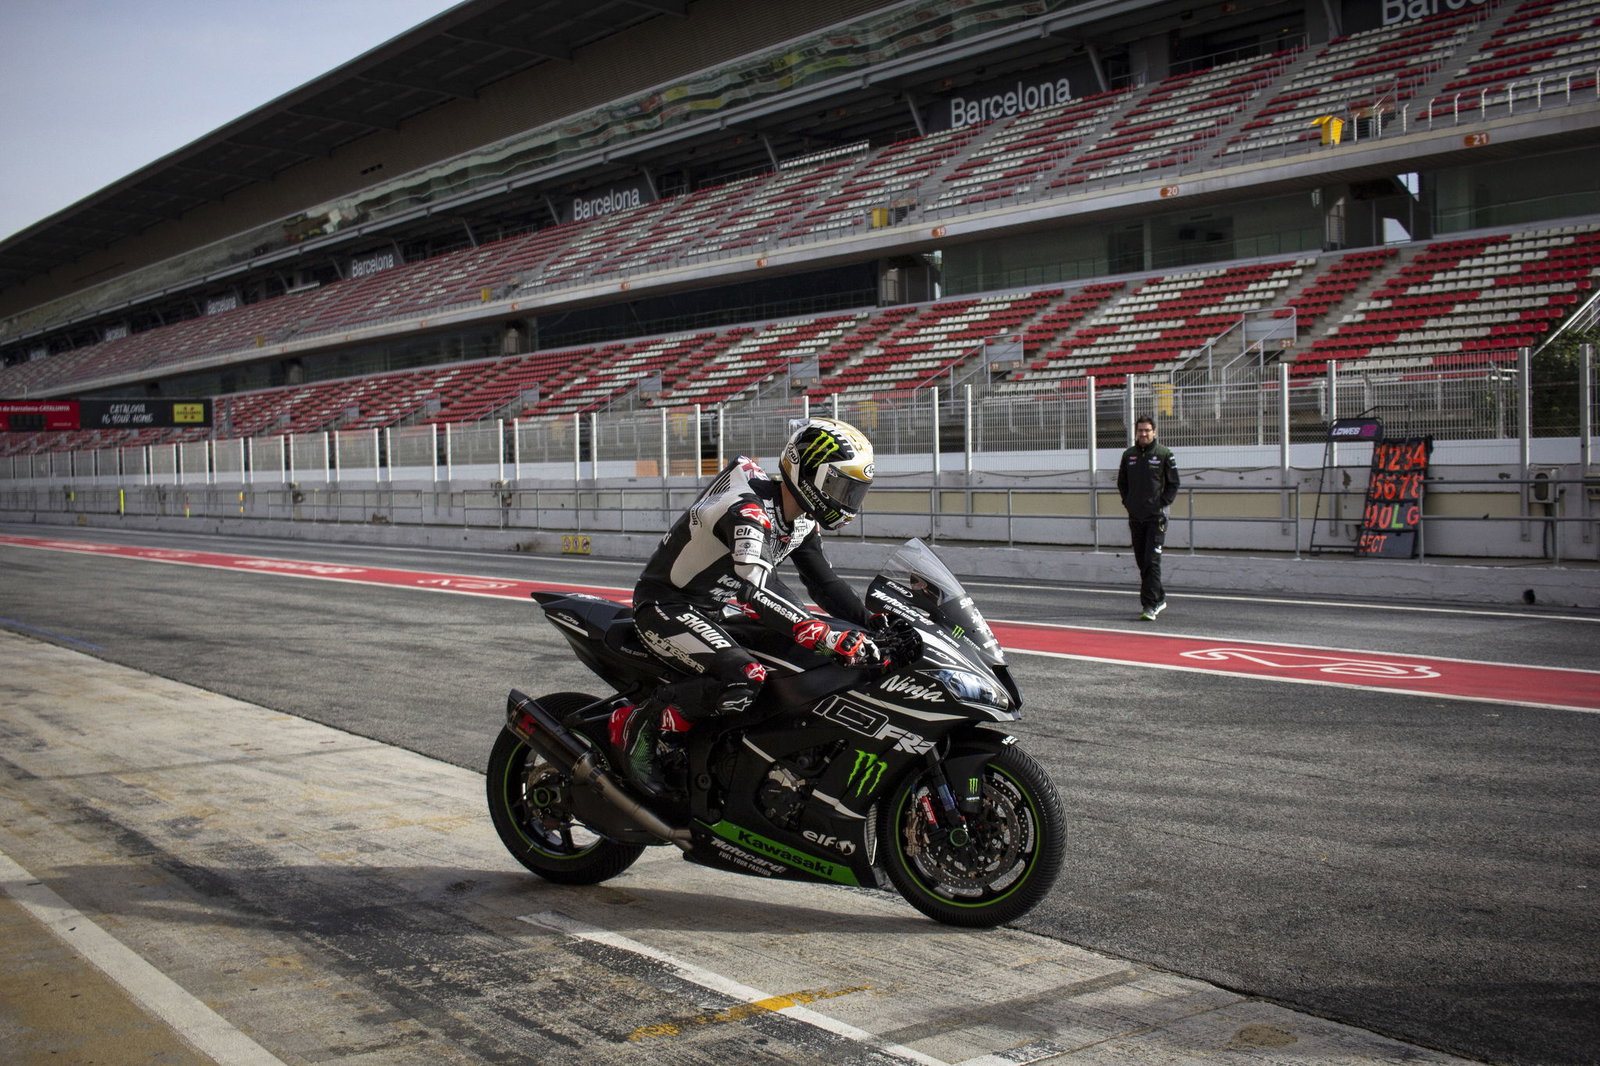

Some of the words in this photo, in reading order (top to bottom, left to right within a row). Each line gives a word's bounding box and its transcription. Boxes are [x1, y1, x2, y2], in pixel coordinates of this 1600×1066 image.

[951, 78, 1071, 128] Barcelona
[1473, 133, 1487, 144] 21
[574, 188, 640, 220] Barcelona
[352, 253, 394, 277] Barcelona
[1332, 427, 1361, 436] LOWES
[802, 480, 828, 511] MONSTER
[736, 527, 752, 536] elf
[1359, 535, 1387, 552] SECT
[753, 590, 804, 623] Kawasaki
[676, 613, 732, 649] SHOWA
[645, 630, 705, 673] alpinestars
[880, 675, 945, 702] Ninja
[802, 830, 837, 847] elf
[718, 851, 731, 861] FUEL
[750, 862, 772, 876] PASSION
[738, 830, 834, 876] Kawasaki
